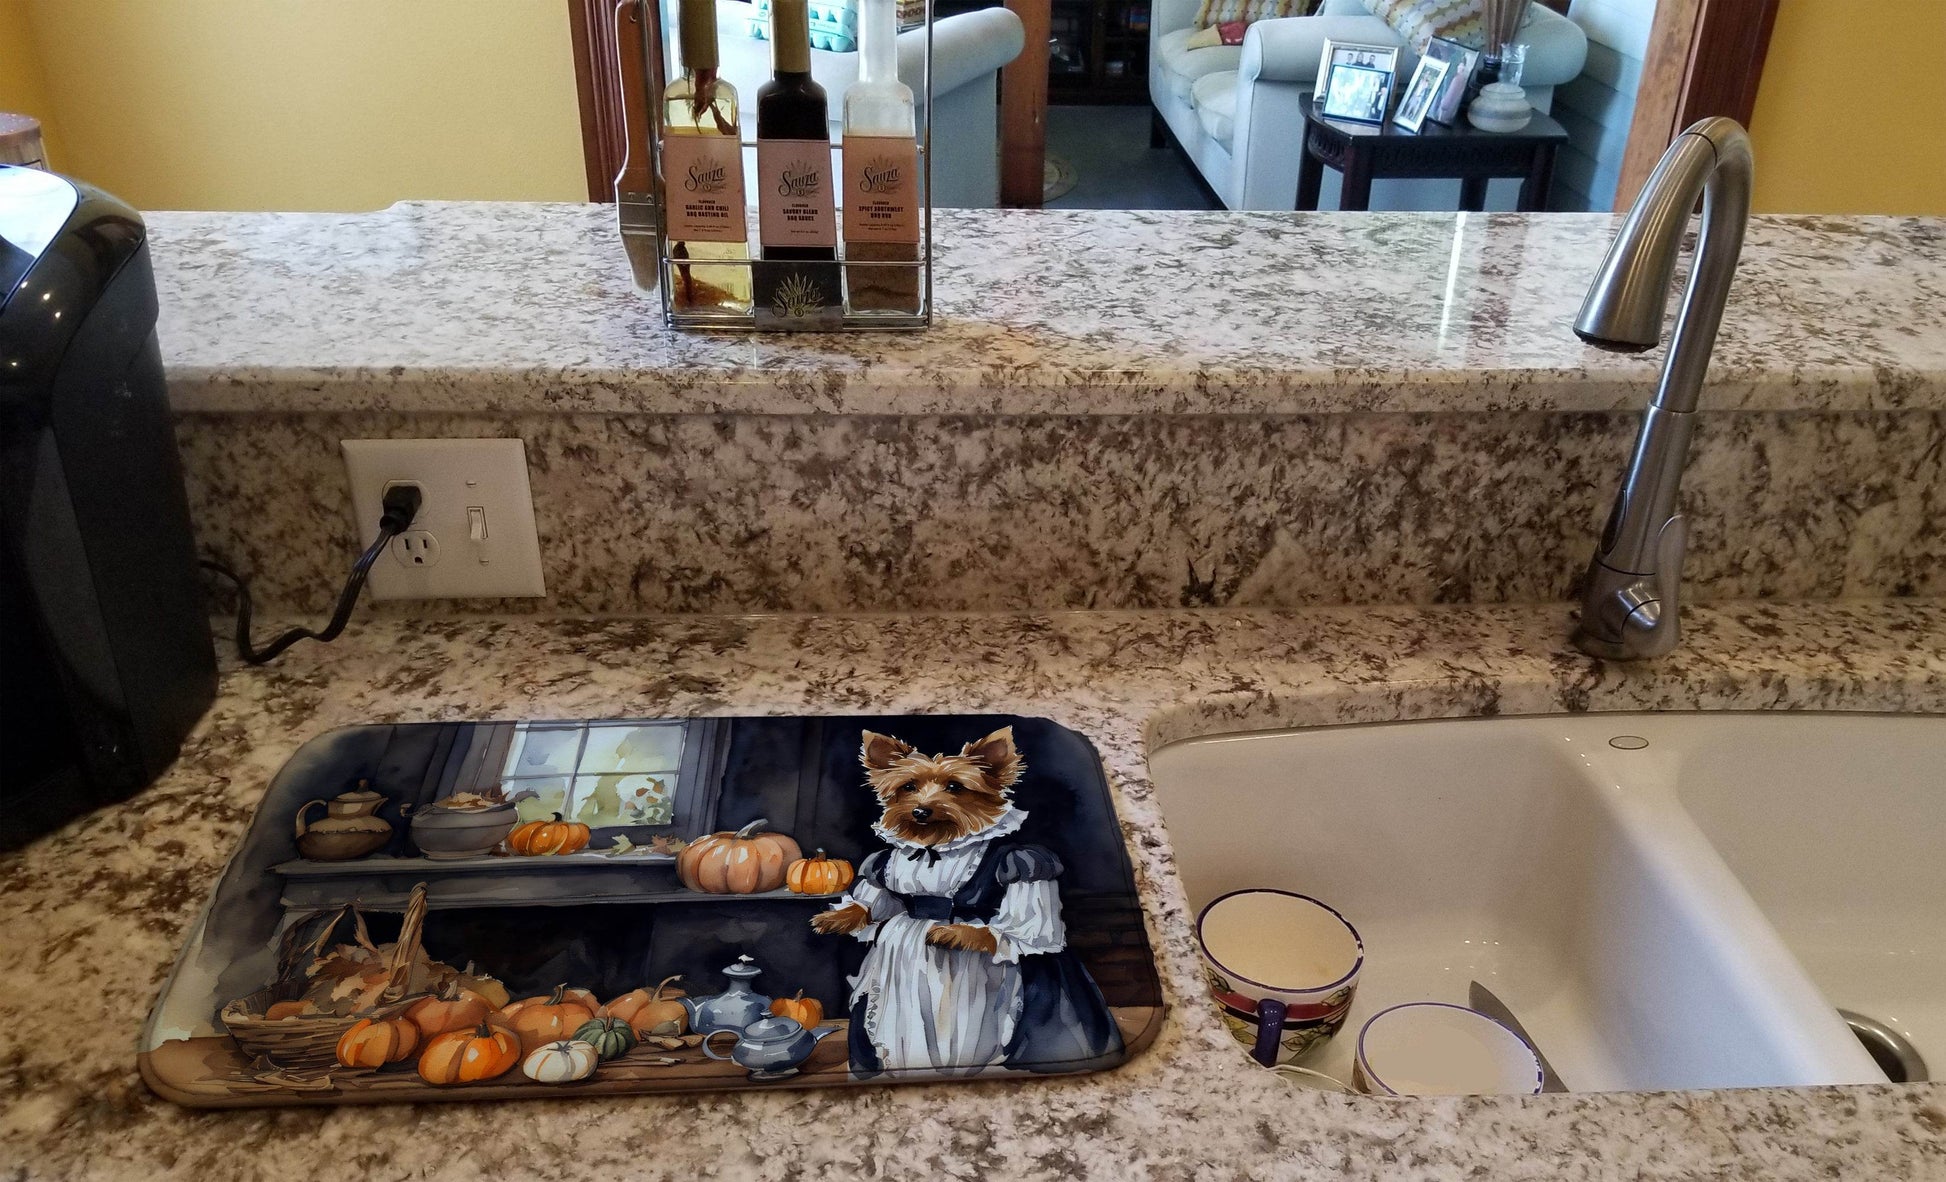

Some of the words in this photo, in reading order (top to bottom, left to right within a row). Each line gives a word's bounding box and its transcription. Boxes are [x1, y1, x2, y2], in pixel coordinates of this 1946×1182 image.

[685, 166, 725, 191] Sauza
[778, 171, 818, 196] Sauza
[859, 167, 899, 192] Sauza
